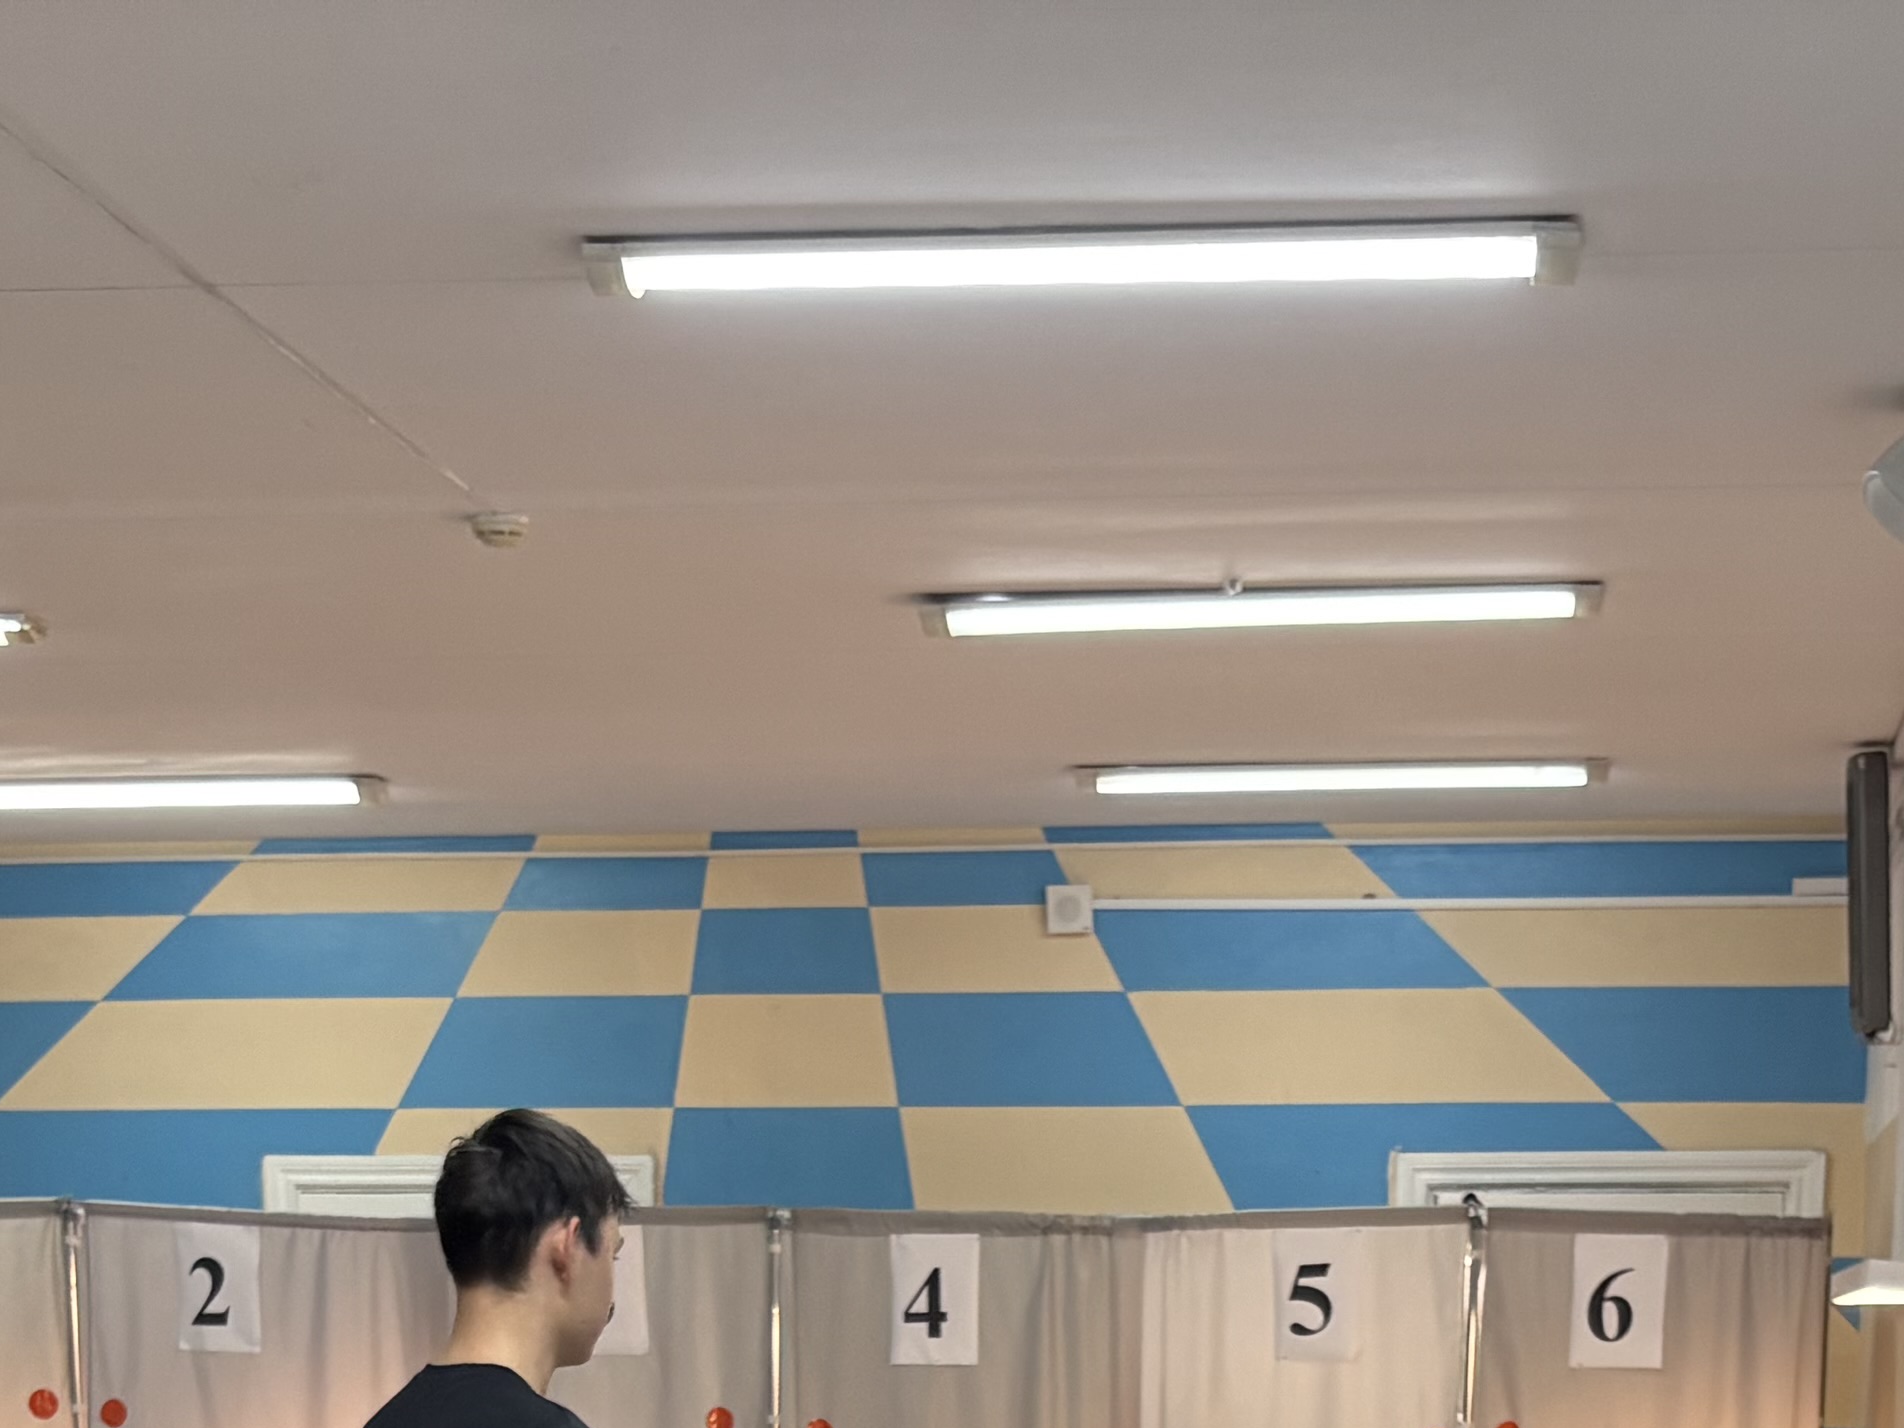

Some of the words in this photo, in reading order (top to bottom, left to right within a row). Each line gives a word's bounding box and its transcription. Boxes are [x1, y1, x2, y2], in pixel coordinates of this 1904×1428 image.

[188, 1256, 231, 1326] 2
[903, 1266, 948, 1338] 4
[1288, 1263, 1333, 1336] 5
[1587, 1268, 1635, 1342] 6
